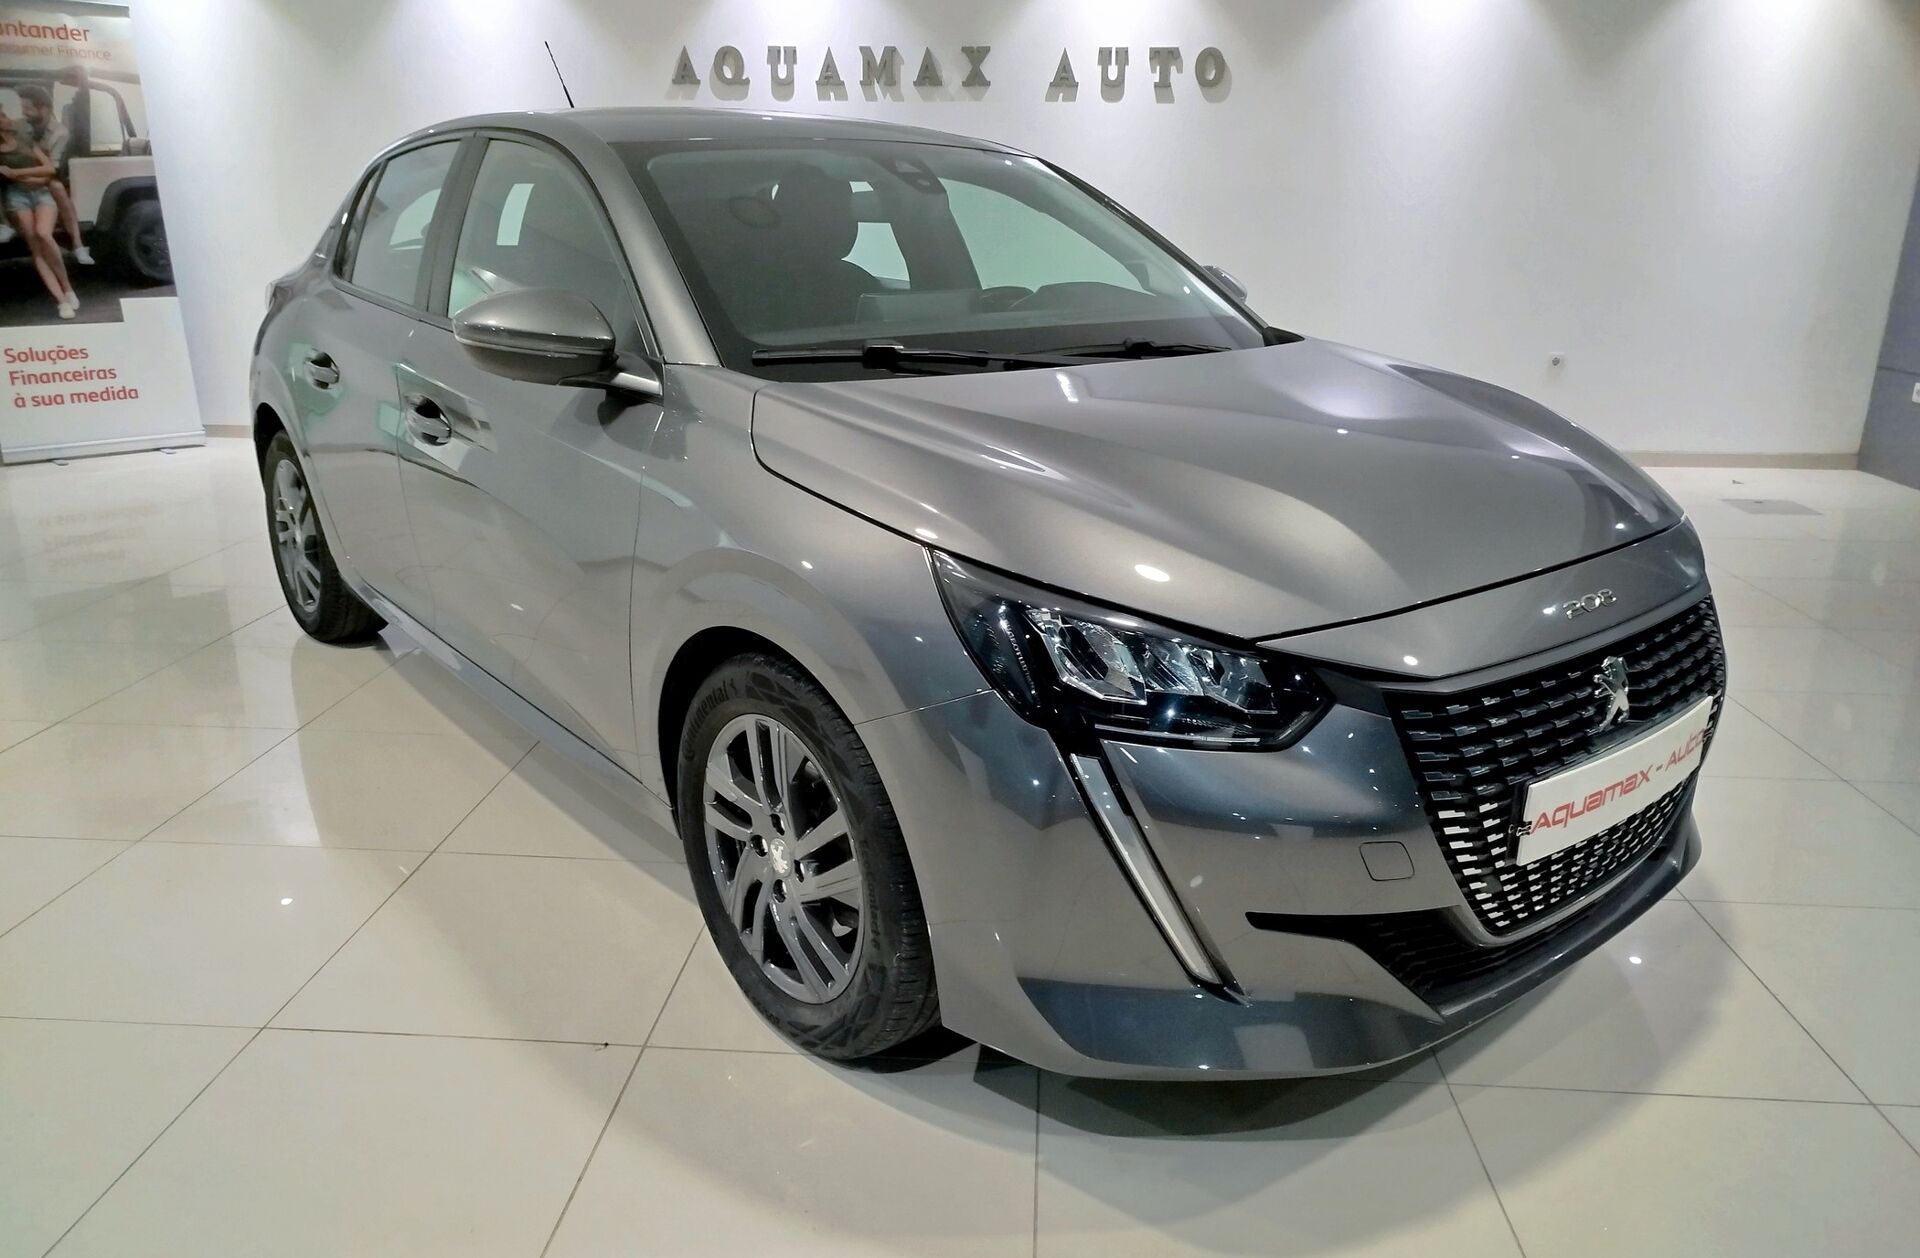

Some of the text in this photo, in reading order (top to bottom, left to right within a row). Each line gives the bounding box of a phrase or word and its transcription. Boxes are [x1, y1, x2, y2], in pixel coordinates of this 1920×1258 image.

[672, 45, 1226, 88] AQUAMAX AUTO
[4, 345, 89, 364] Soluções
[9, 366, 117, 386] Financeiras
[14, 385, 139, 408] à sua medida
[1531, 764, 1653, 834] Aquamax
